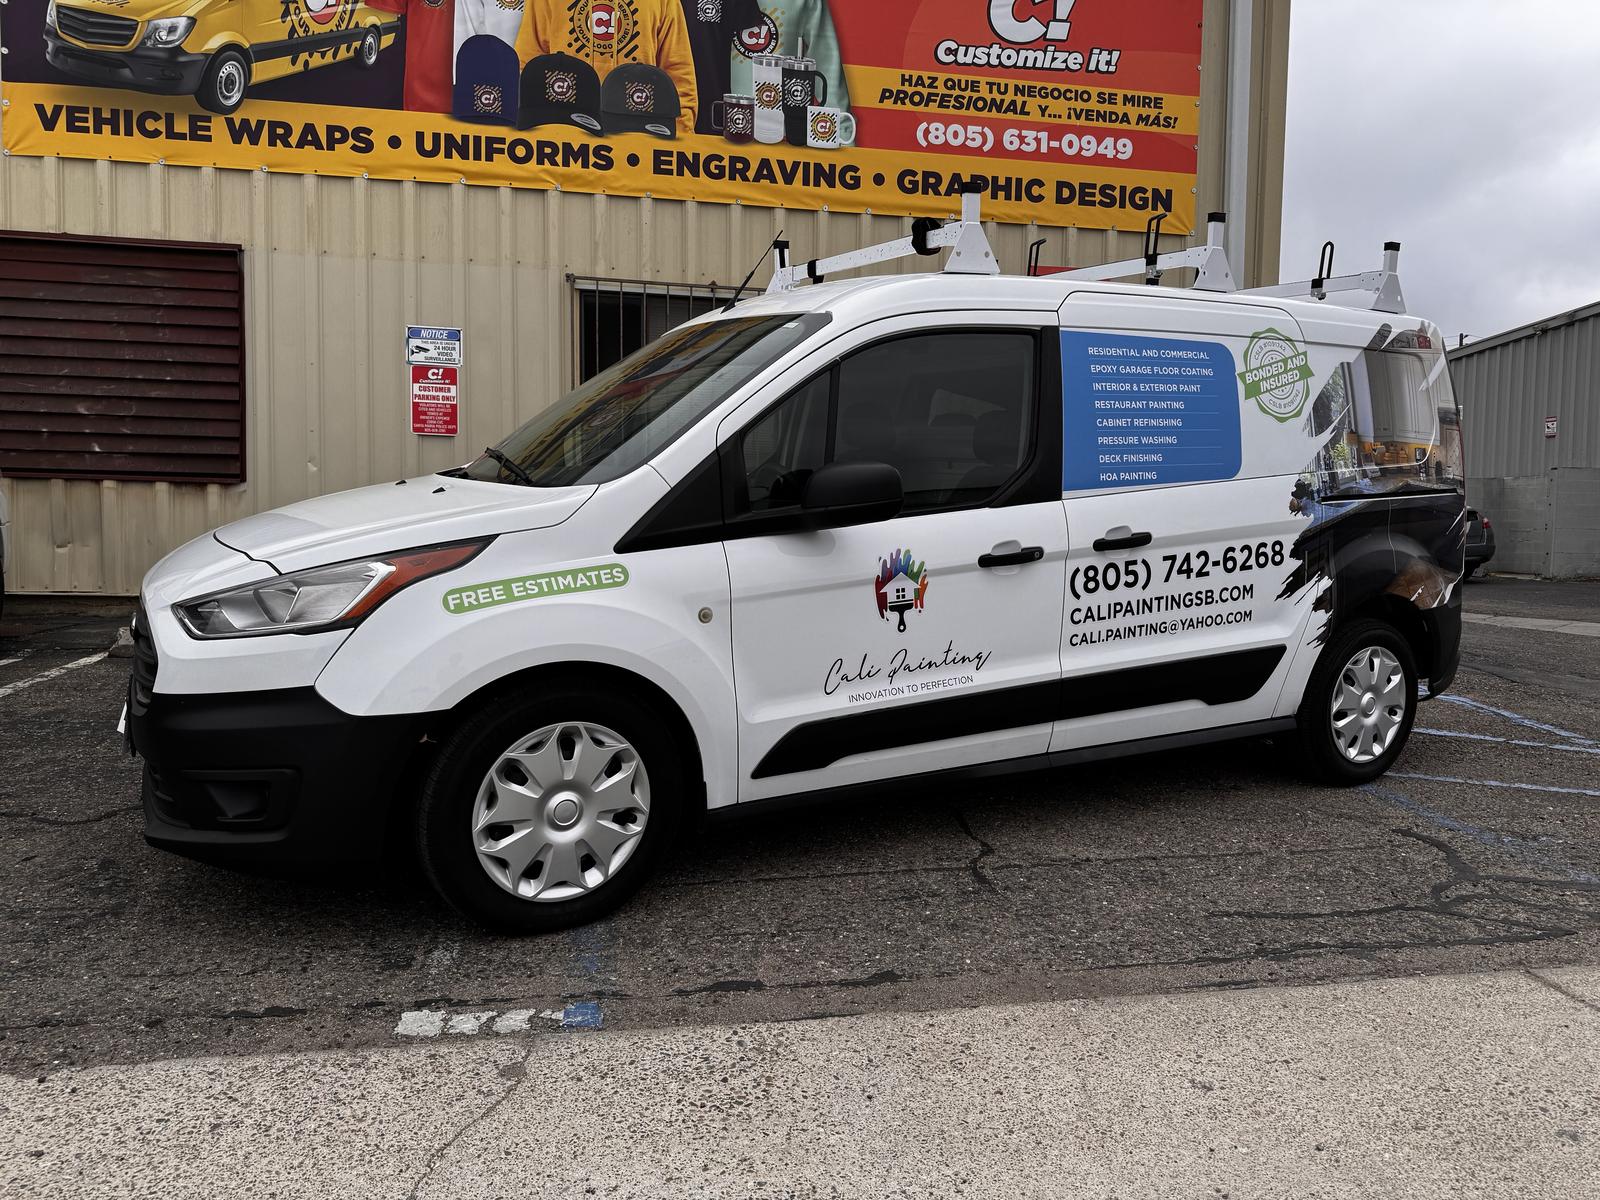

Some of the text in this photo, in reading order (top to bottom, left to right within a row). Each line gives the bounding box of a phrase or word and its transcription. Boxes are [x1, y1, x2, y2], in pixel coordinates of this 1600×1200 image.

[588, 11, 620, 35] C!
[988, 0, 1076, 44] C!
[741, 25, 769, 45] C!
[593, 41, 613, 50] LOGO
[732, 36, 745, 53] YOUR
[935, 40, 1121, 74] Customize it!
[553, 81, 569, 92] C!
[900, 73, 1164, 110] HAZ QUE TU NEGOCIO SE MIRE
[481, 94, 495, 104] C!
[633, 92, 647, 102] C!
[762, 91, 775, 101] C!
[878, 88, 1031, 116] PROFESIONAL
[1067, 107, 1132, 126] ¡VENDA
[1135, 112, 1179, 129] MÁS!
[817, 122, 831, 132] C!
[916, 121, 1133, 160] (805) 631-0949
[34, 103, 1173, 213] VEHICLE WRAPS UNIFORMS ENGRAVING GRAPHIC DESIGN
[420, 329, 448, 339] NOTICE
[1088, 347, 1209, 360] RESIDENTIAL AND COMMERCIAL
[427, 368, 444, 380] C!
[1091, 364, 1213, 377] EPOXY GARAGE FLOOR COATING
[1245, 354, 1306, 384] BONDED AND
[1093, 382, 1201, 393] INTERIOR & EXTERIOR PAINT
[1260, 370, 1300, 392] INSURED
[418, 385, 451, 393] CUSTOMER
[414, 393, 440, 401] PARKING
[1095, 400, 1185, 410] RESTAURANT PAINTING
[1096, 418, 1183, 427] CABINET REFINISHING
[1098, 435, 1178, 446] PRESSURE WASHING
[1099, 453, 1163, 463] DECK FINISHING
[1100, 471, 1157, 481] HOA PAINTING
[1069, 540, 1285, 600] (805) 742-6268
[447, 567, 625, 610] FREE ESTIMATES
[1070, 584, 1254, 625] CALIPAINTINGSB.COM
[1069, 610, 1252, 646] CALI.PAINTING@YAHOO.COM
[824, 639, 992, 695] Cali Painting
[848, 675, 974, 703] INNOVATION TO PERFECTION
